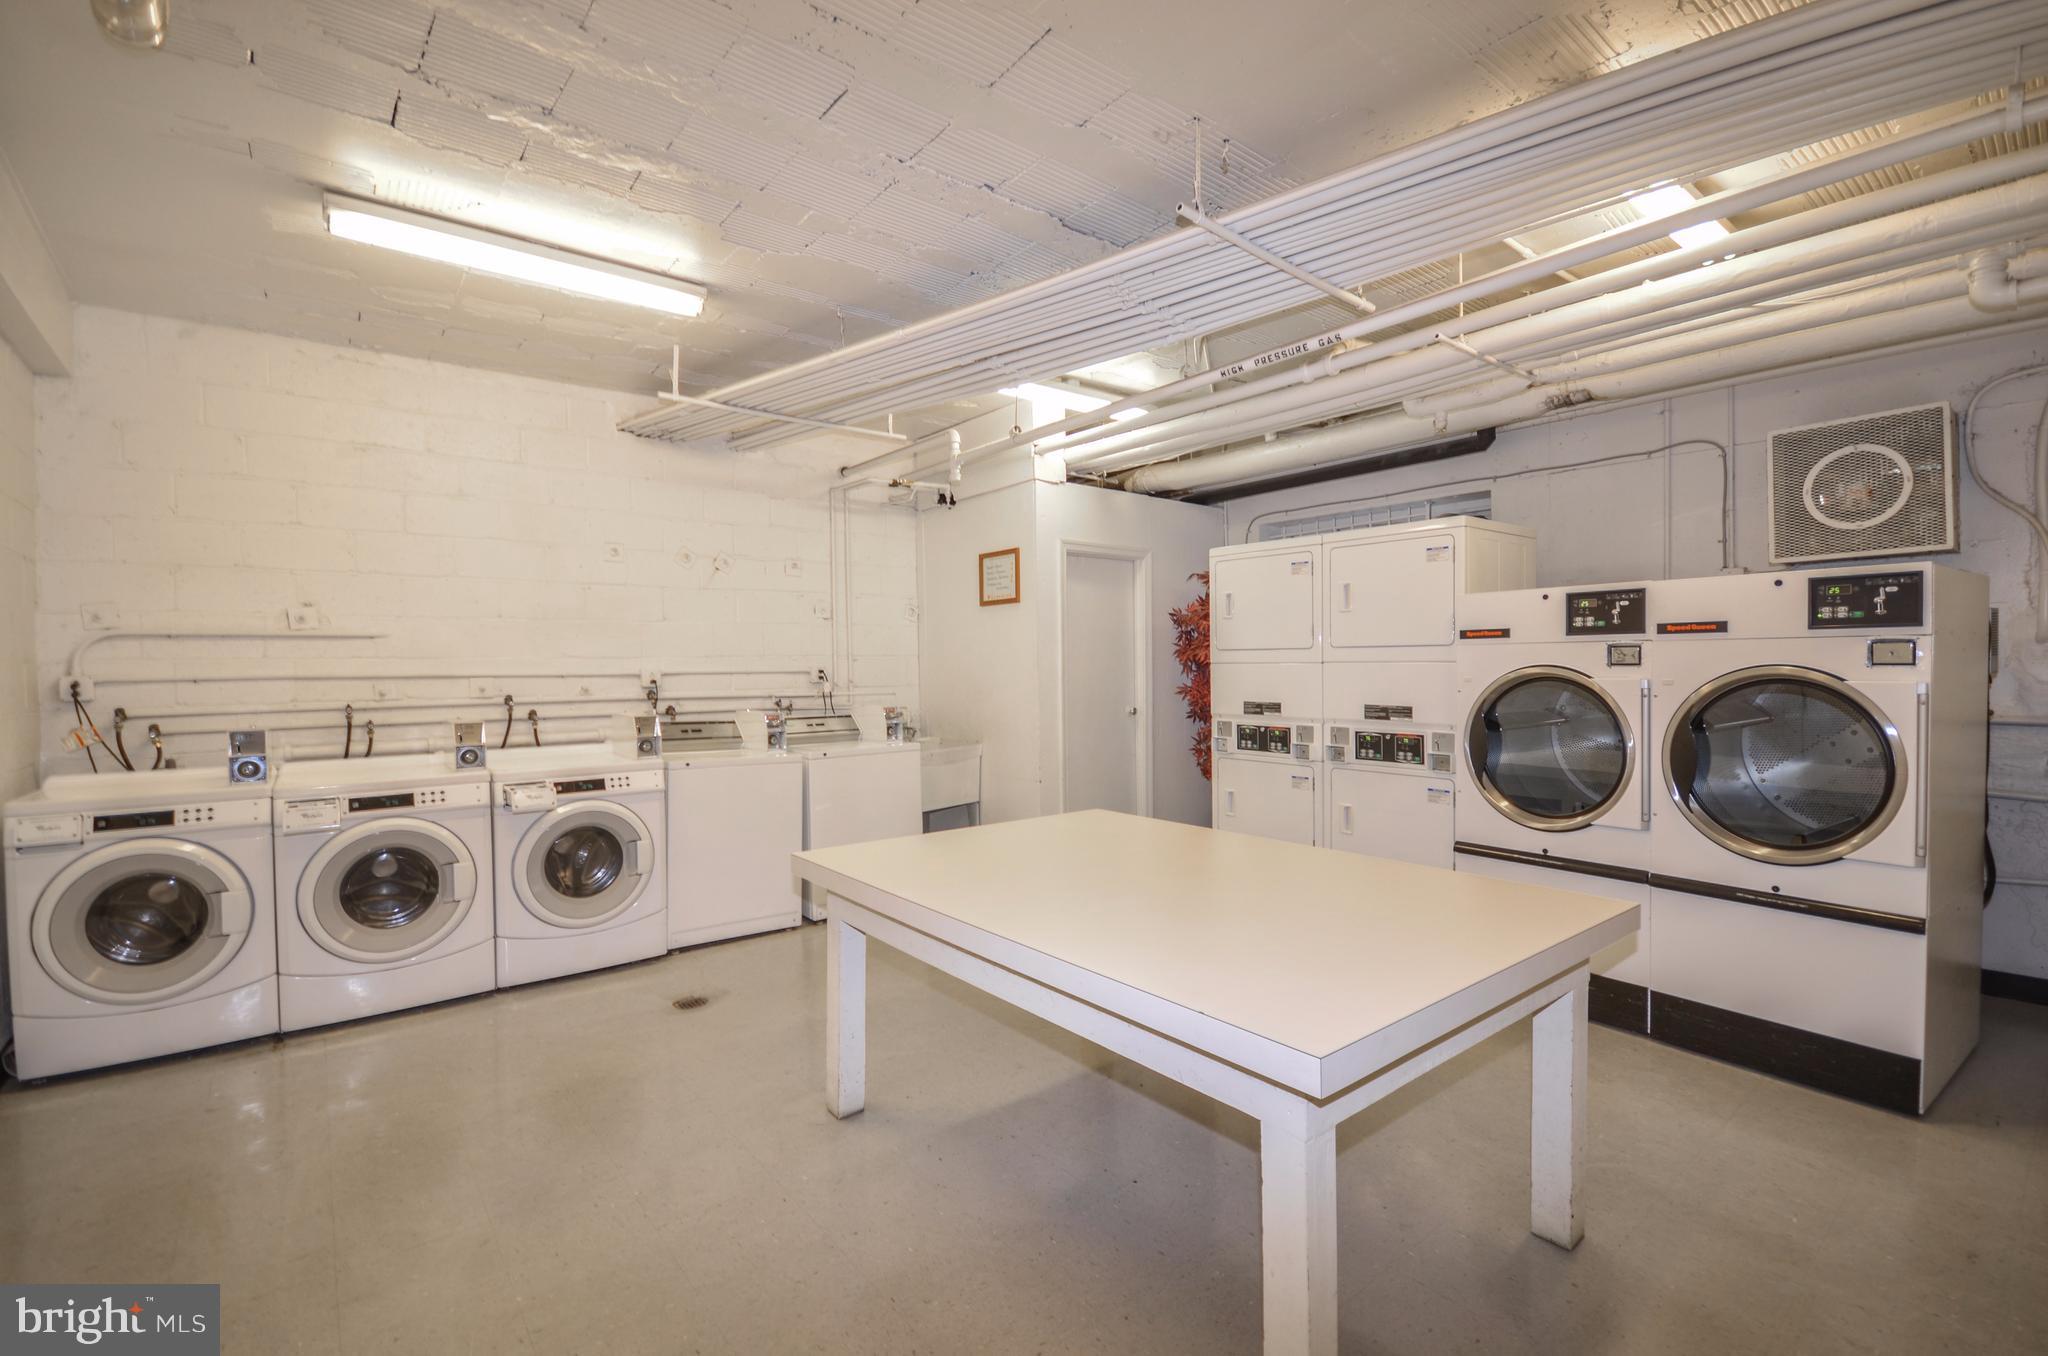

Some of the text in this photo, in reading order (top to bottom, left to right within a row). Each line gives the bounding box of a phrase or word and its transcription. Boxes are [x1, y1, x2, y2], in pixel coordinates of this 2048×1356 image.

[1220, 333, 1342, 377] HIGH PRESSURE GAS
